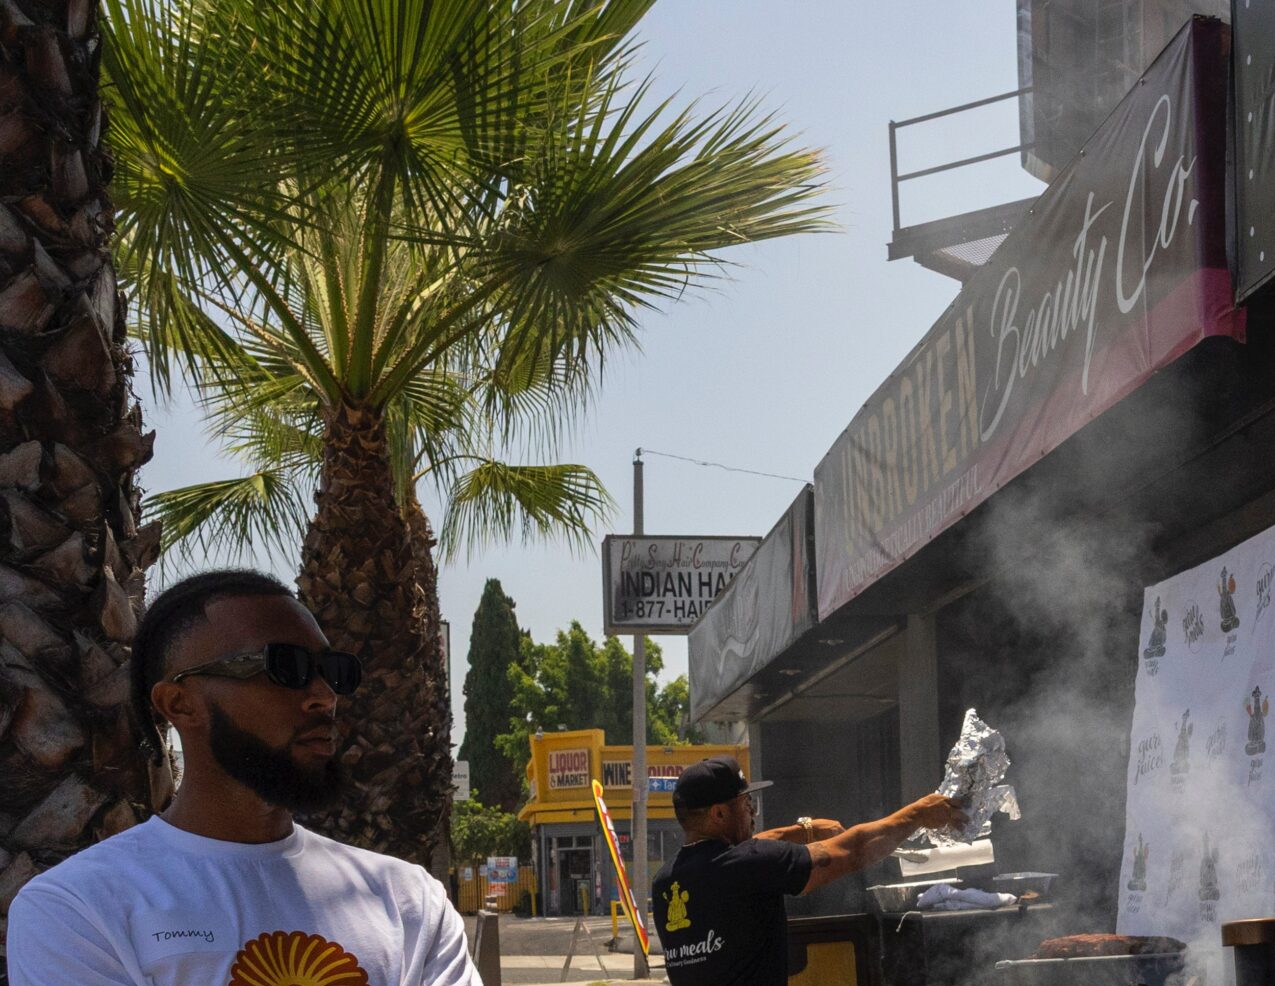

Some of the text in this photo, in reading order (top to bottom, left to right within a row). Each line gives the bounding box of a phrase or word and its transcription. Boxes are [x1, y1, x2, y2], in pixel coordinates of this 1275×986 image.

[842, 94, 1200, 556] UNBROKEN Beauty Co.
[621, 572, 737, 598] INDIAN HA
[549, 751, 587, 774] LIQUOR
[603, 762, 631, 786] WINE
[557, 773, 588, 787] MARKET
[152, 928, 215, 943] Tommy
[679, 929, 725, 958] meals
